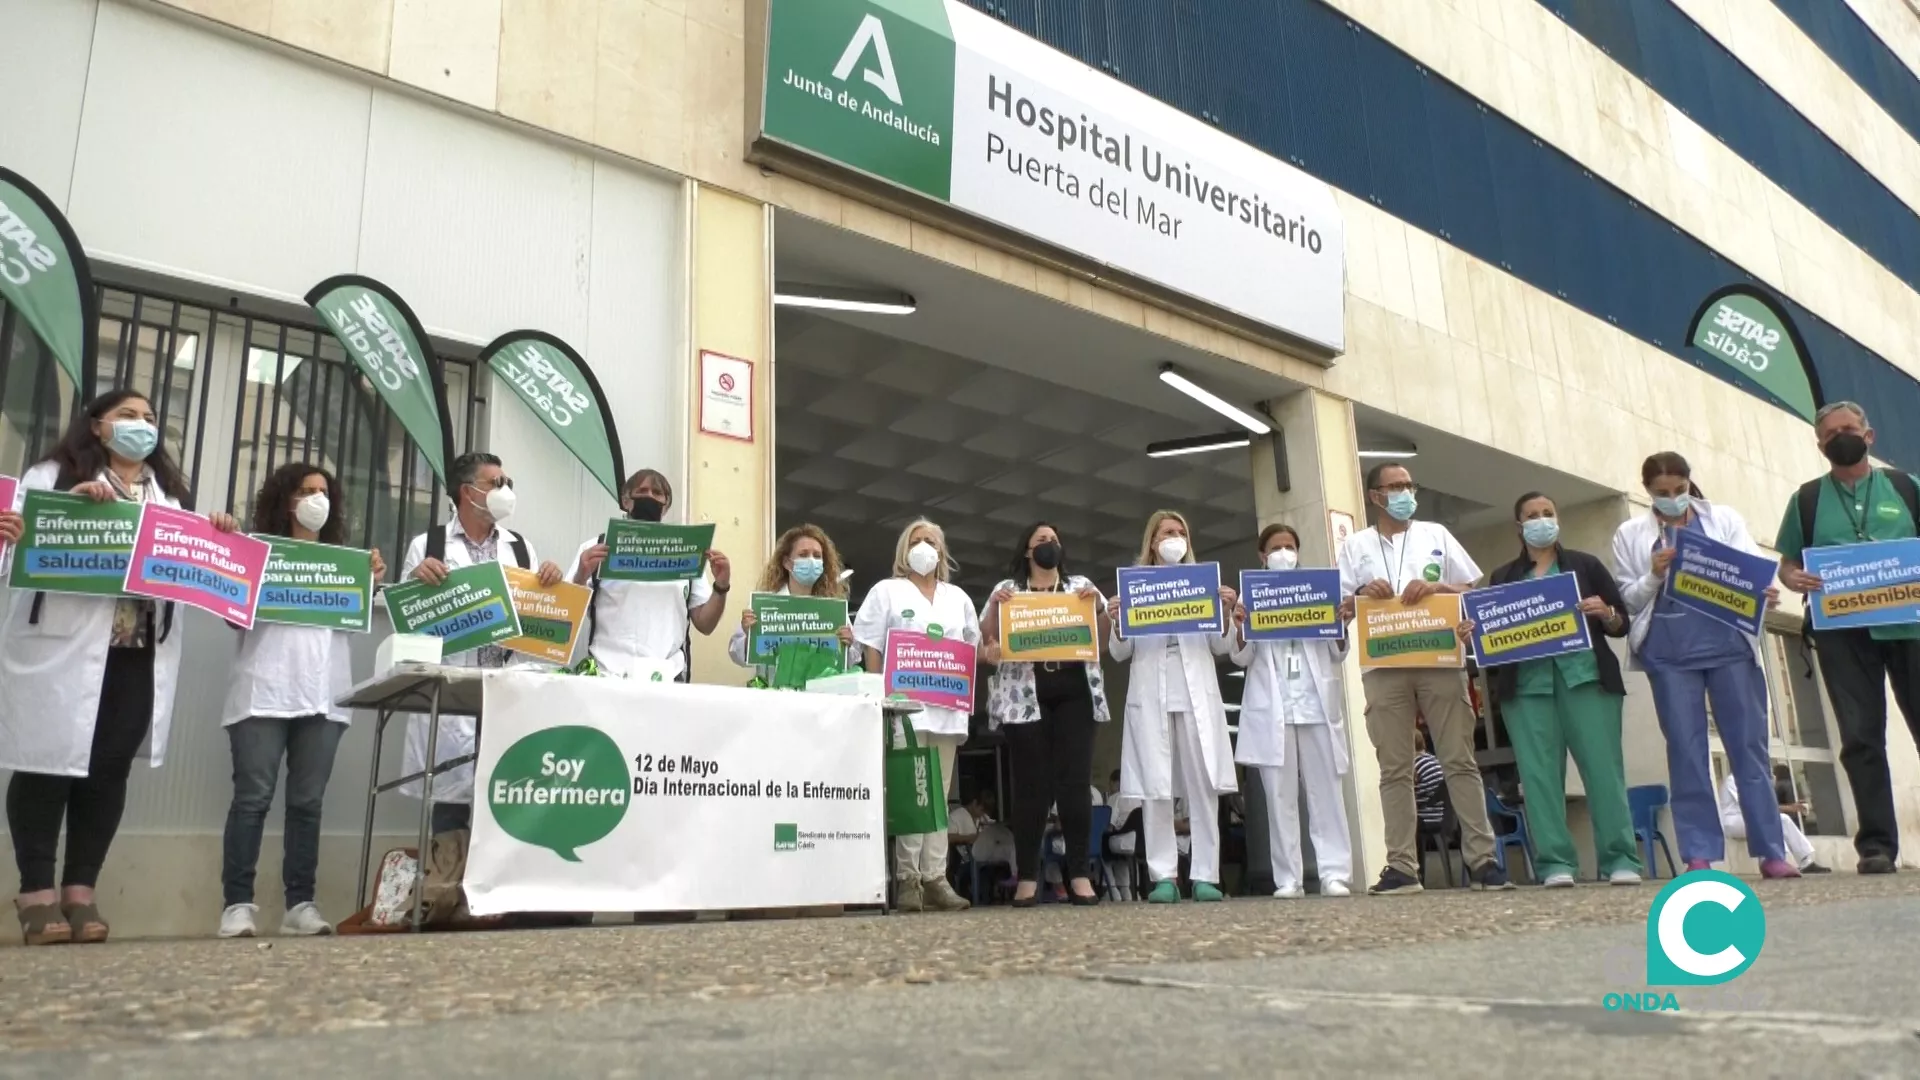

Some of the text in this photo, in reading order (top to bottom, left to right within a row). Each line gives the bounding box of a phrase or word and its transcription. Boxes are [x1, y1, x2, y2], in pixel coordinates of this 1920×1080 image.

[783, 68, 940, 146] Junta de Andalucía
[988, 73, 1322, 254] Hospital Universitario
[987, 131, 1182, 240] Puerta del Mar
[36, 515, 133, 531] Enfermeras
[35, 531, 137, 548] para un futu
[154, 528, 231, 557] Enfermeras
[616, 535, 684, 545] Enfermeras
[616, 544, 698, 554] para un futuro
[38, 552, 127, 570] saludab
[152, 543, 246, 575] para un futuro
[266, 559, 338, 573] nfermeras
[617, 557, 692, 569] saludable
[1820, 556, 1900, 580] Enfermeras
[151, 563, 239, 597] equitativo
[295, 574, 312, 583] un
[315, 573, 355, 584] futuro
[1129, 579, 1190, 595] Enfermeras
[1707, 568, 1719, 579] un
[1721, 570, 1753, 590] futuro
[1823, 580, 1855, 594] para
[1857, 574, 1876, 585] un
[265, 589, 350, 607] saludable
[401, 583, 472, 616] Enfermeras
[511, 587, 556, 603] fermeras
[1131, 587, 1206, 607] para un futuro
[1251, 583, 1312, 598] Enfermeras
[1681, 576, 1748, 610] innovador
[407, 612, 437, 630] para
[436, 604, 453, 614] un
[453, 587, 492, 608] futuro
[523, 603, 534, 611] un
[535, 602, 569, 617] futuro
[1254, 591, 1327, 610] para un futuro
[1477, 594, 1545, 620] Enfermeras
[761, 611, 819, 622] Enfermeras
[1010, 606, 1068, 620] Enfermeras
[1135, 604, 1205, 620] innovador
[1257, 609, 1326, 625] innovador
[1367, 609, 1430, 624] Enfermeras
[1482, 600, 1565, 635] para un futuro
[761, 620, 834, 635] para un futuro
[1011, 614, 1083, 632] para un futuro
[1368, 617, 1446, 637] para un futuro
[1489, 620, 1566, 648] innovador
[897, 647, 954, 660] Enfermeras
[1378, 637, 1440, 652] inclusivo
[897, 659, 966, 672] para un futuro
[898, 674, 963, 690] equitativo
[540, 751, 585, 782] Soy
[634, 753, 719, 778] 12 de Mayo
[634, 776, 871, 801] Día Internacional de la Enfermería
[914, 755, 928, 807] SATSE
[493, 779, 625, 806] Enfermera
